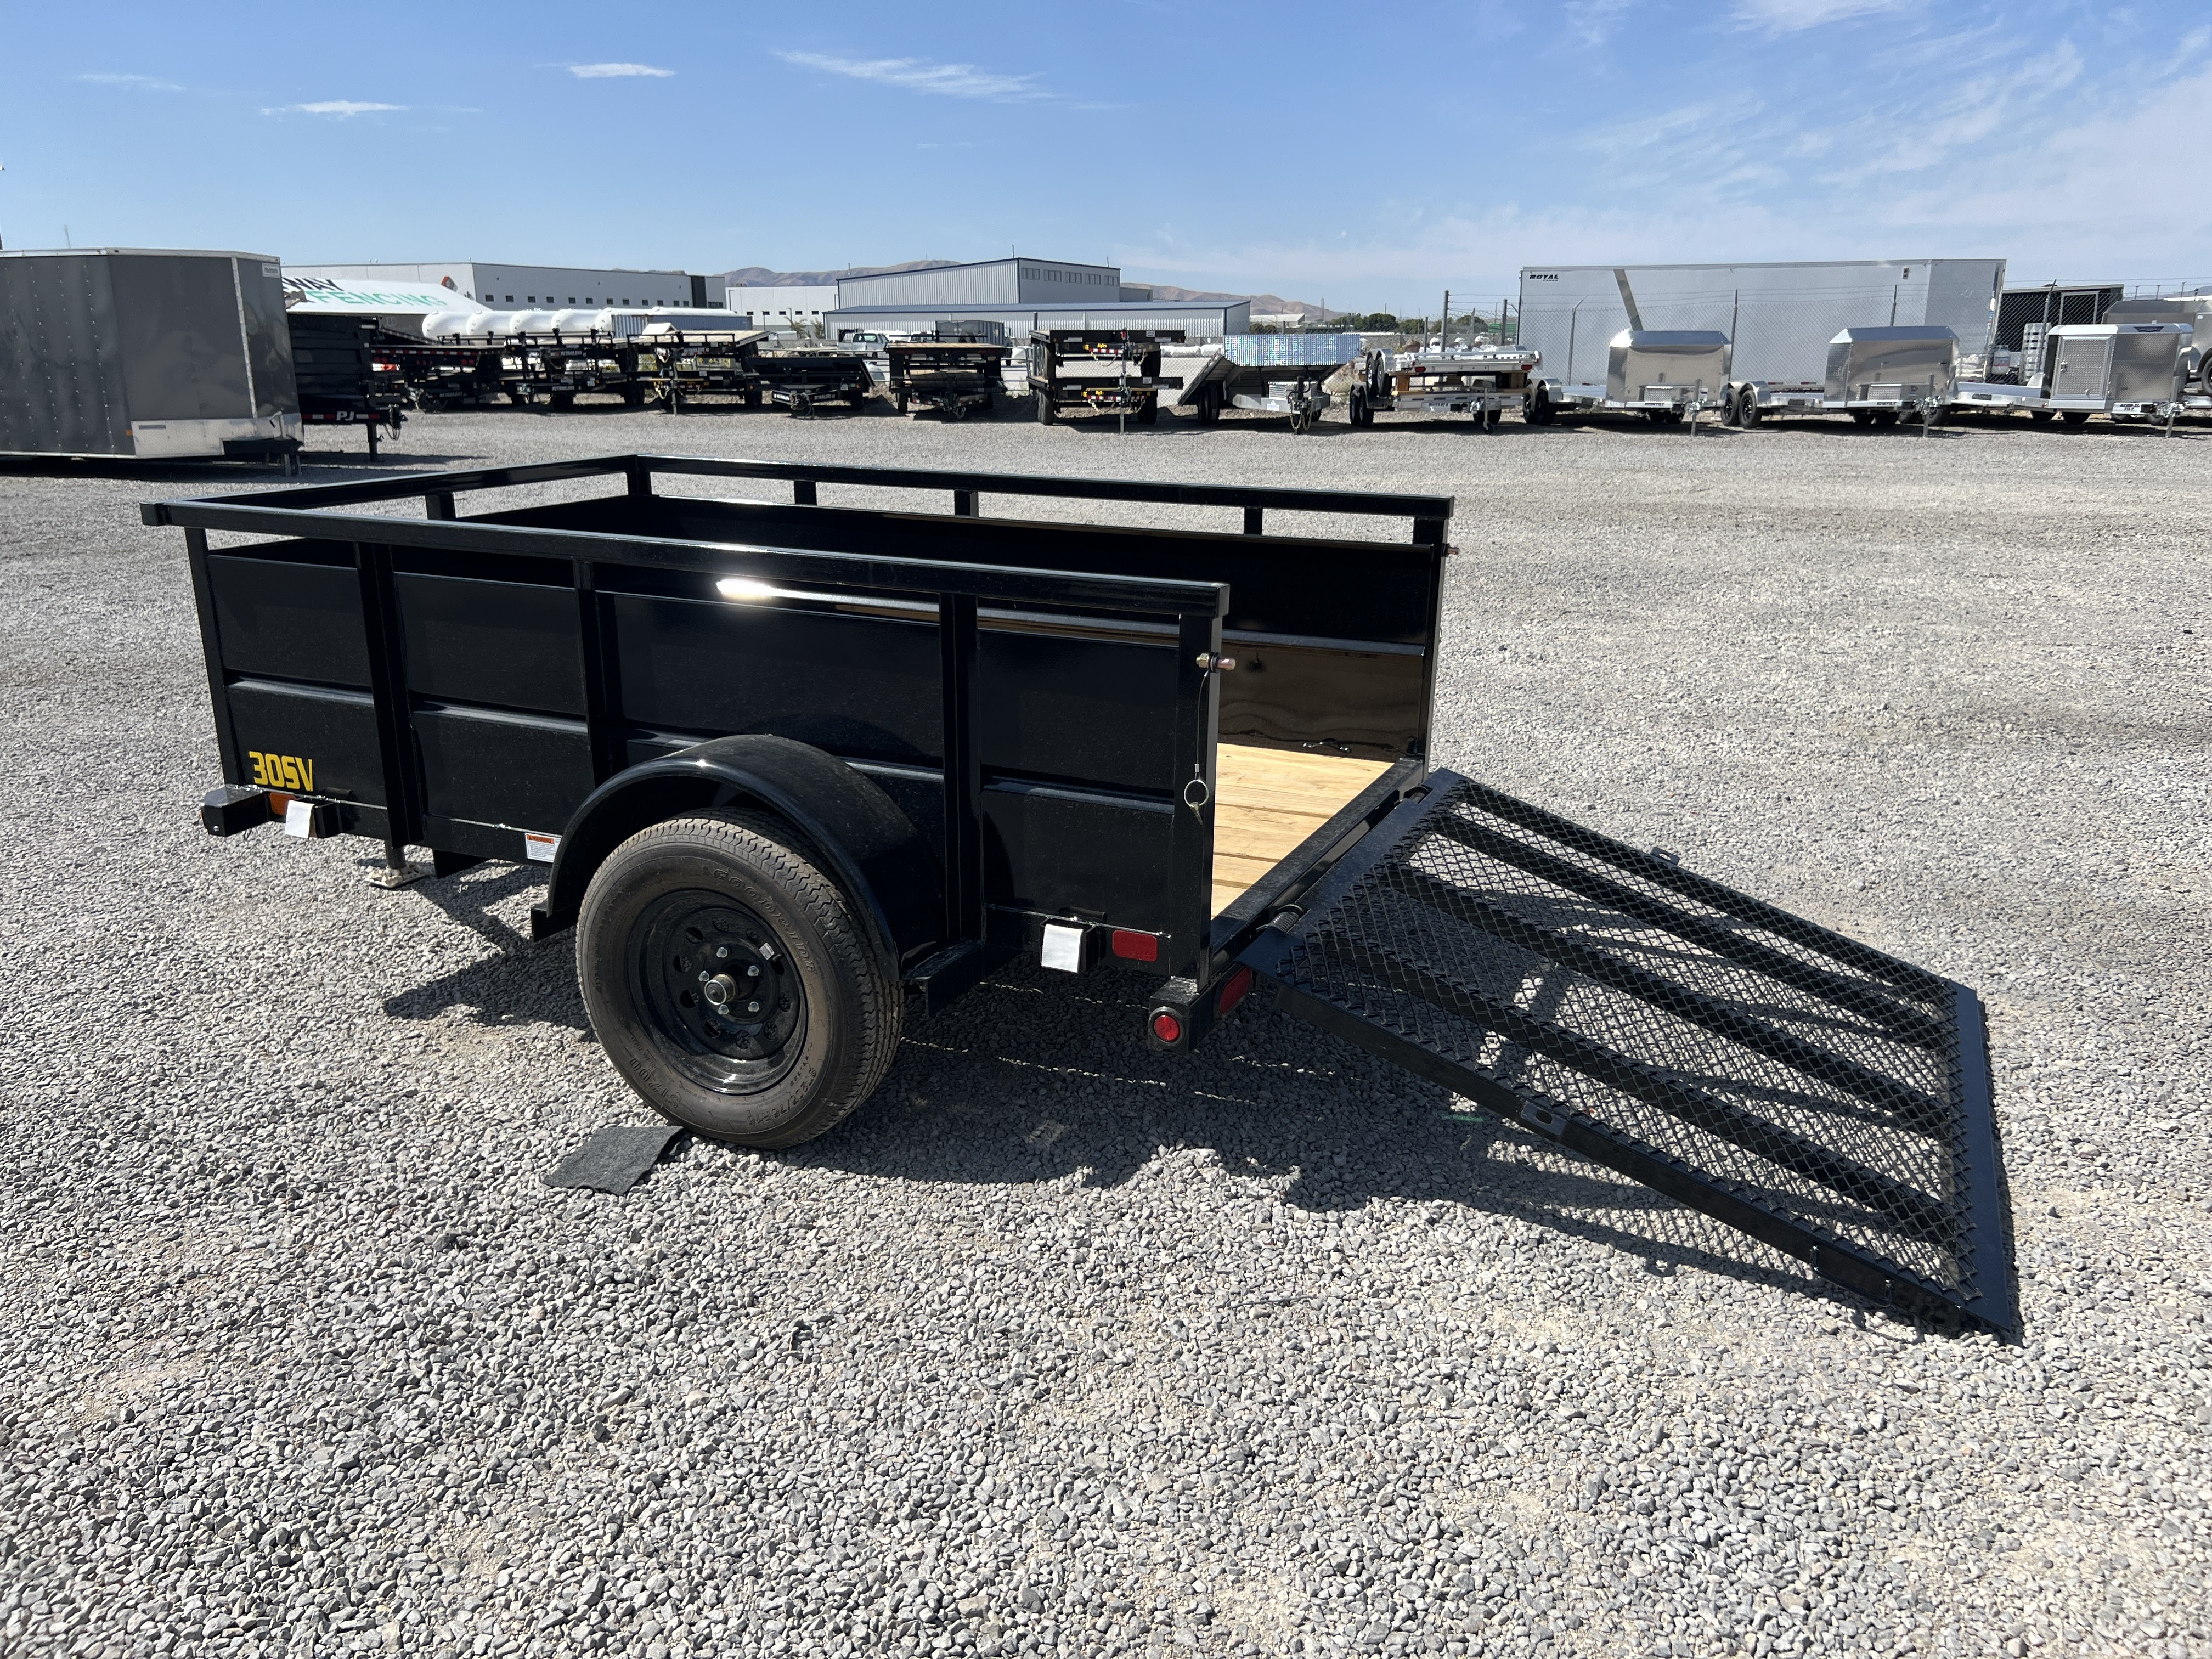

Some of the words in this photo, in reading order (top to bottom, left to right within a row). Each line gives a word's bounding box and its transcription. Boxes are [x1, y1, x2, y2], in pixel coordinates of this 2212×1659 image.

[282, 277, 345, 291] WAY
[305, 291, 447, 305] FENCING
[336, 411, 354, 421] PJ
[249, 751, 313, 792] 30SV
